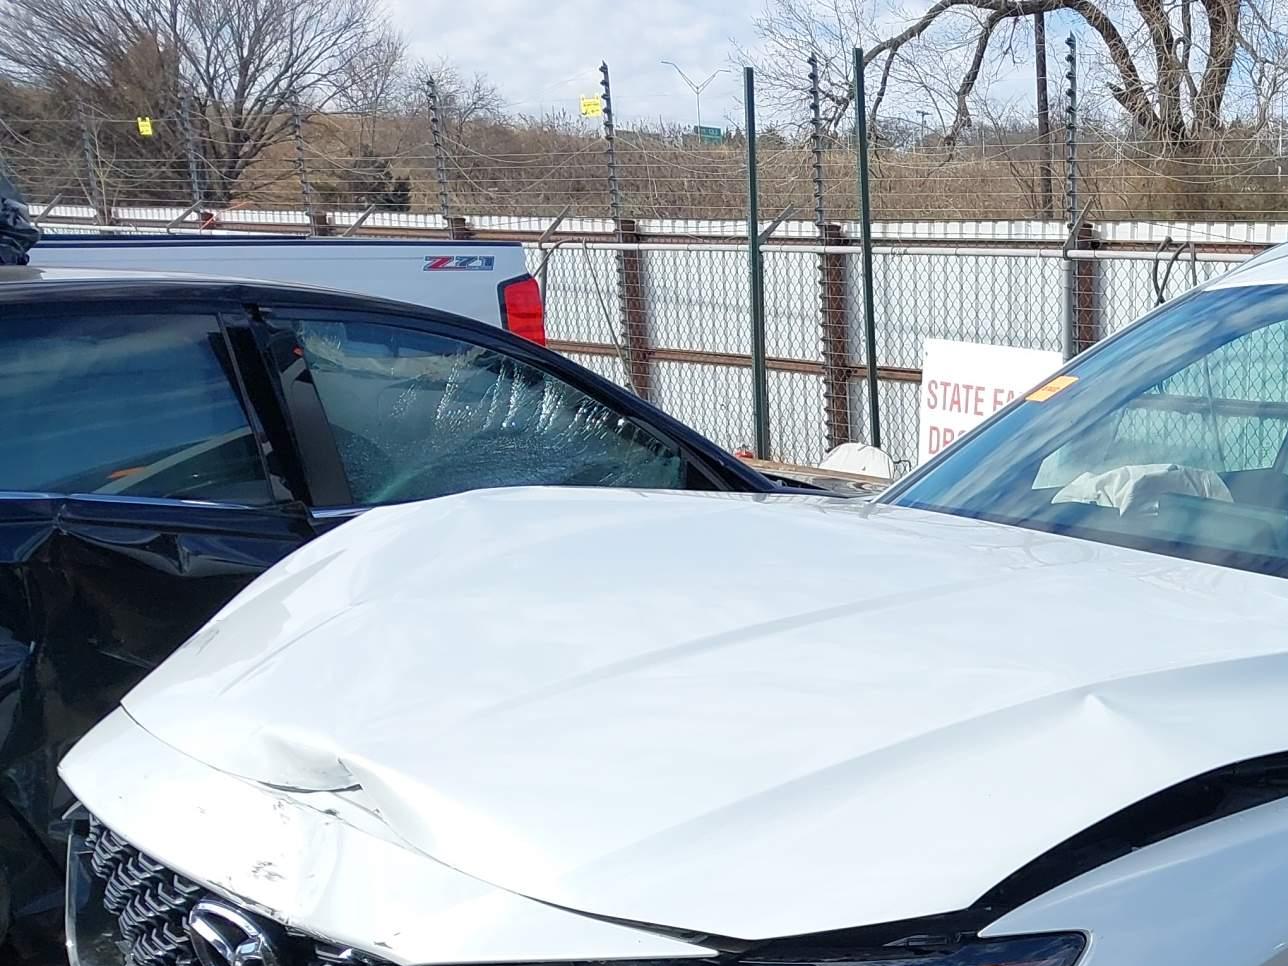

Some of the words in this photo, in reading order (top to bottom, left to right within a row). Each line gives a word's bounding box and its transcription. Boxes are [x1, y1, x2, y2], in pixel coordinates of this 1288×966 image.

[423, 255, 495, 272] Z71
[927, 379, 985, 416] STATE
[992, 388, 1022, 413] FA
[928, 425, 967, 455] DR
